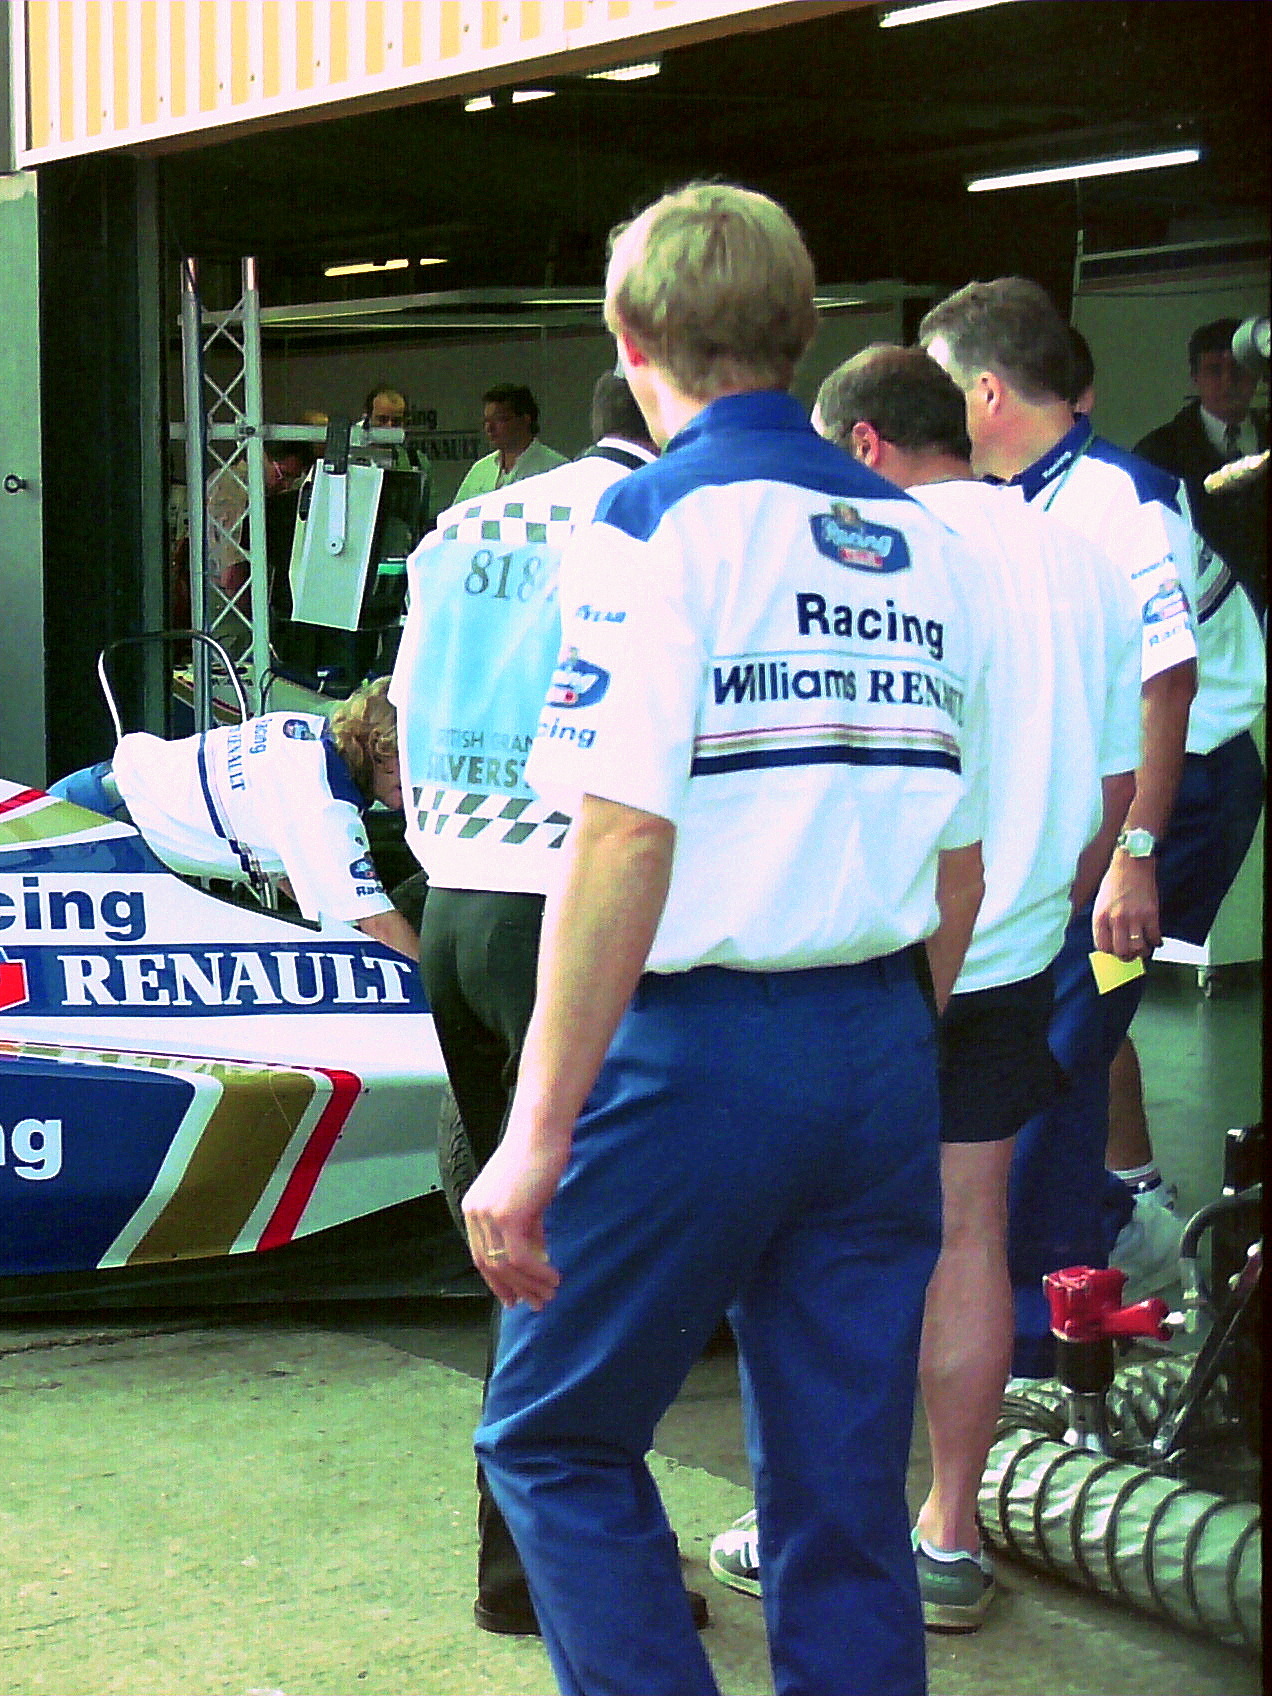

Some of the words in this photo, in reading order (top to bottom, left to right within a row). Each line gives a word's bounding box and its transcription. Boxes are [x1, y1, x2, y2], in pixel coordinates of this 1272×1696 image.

[464, 549, 558, 603] 818
[797, 592, 943, 662] Racing
[57, 951, 413, 1007] RENAULT
